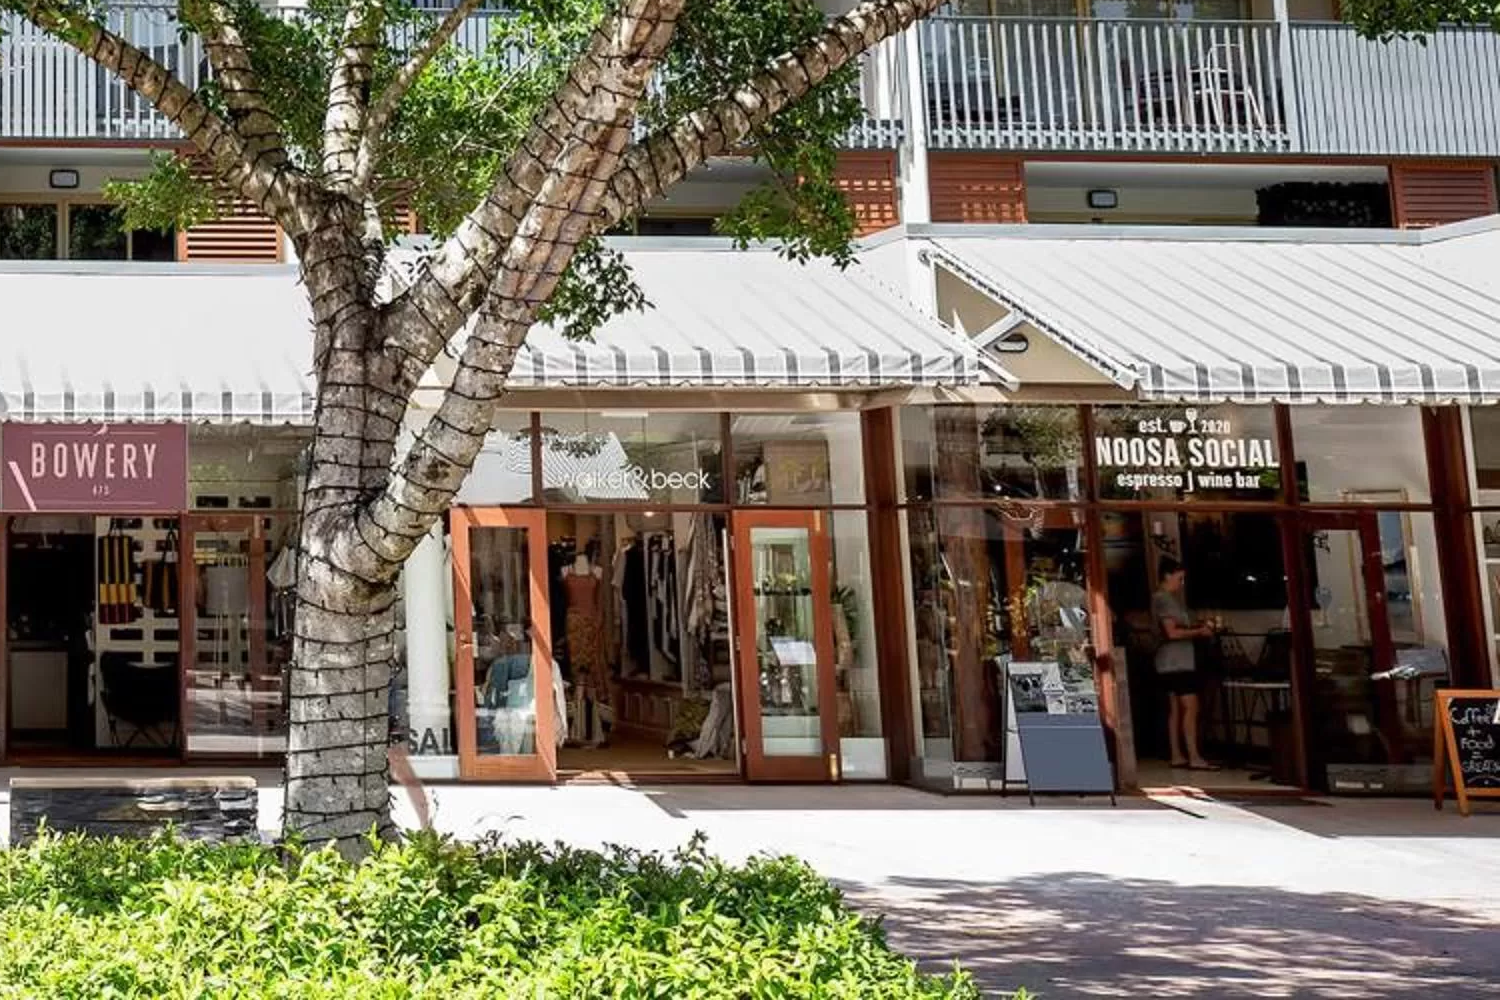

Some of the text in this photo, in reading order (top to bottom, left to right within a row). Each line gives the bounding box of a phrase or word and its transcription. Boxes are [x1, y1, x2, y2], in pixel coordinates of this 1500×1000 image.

[1138, 417, 1231, 434] est. 2020
[31, 442, 157, 479] BOWERY
[1095, 437, 1280, 467] NOOSA SOCIAL
[1117, 471, 1261, 490] espresso wine bar
